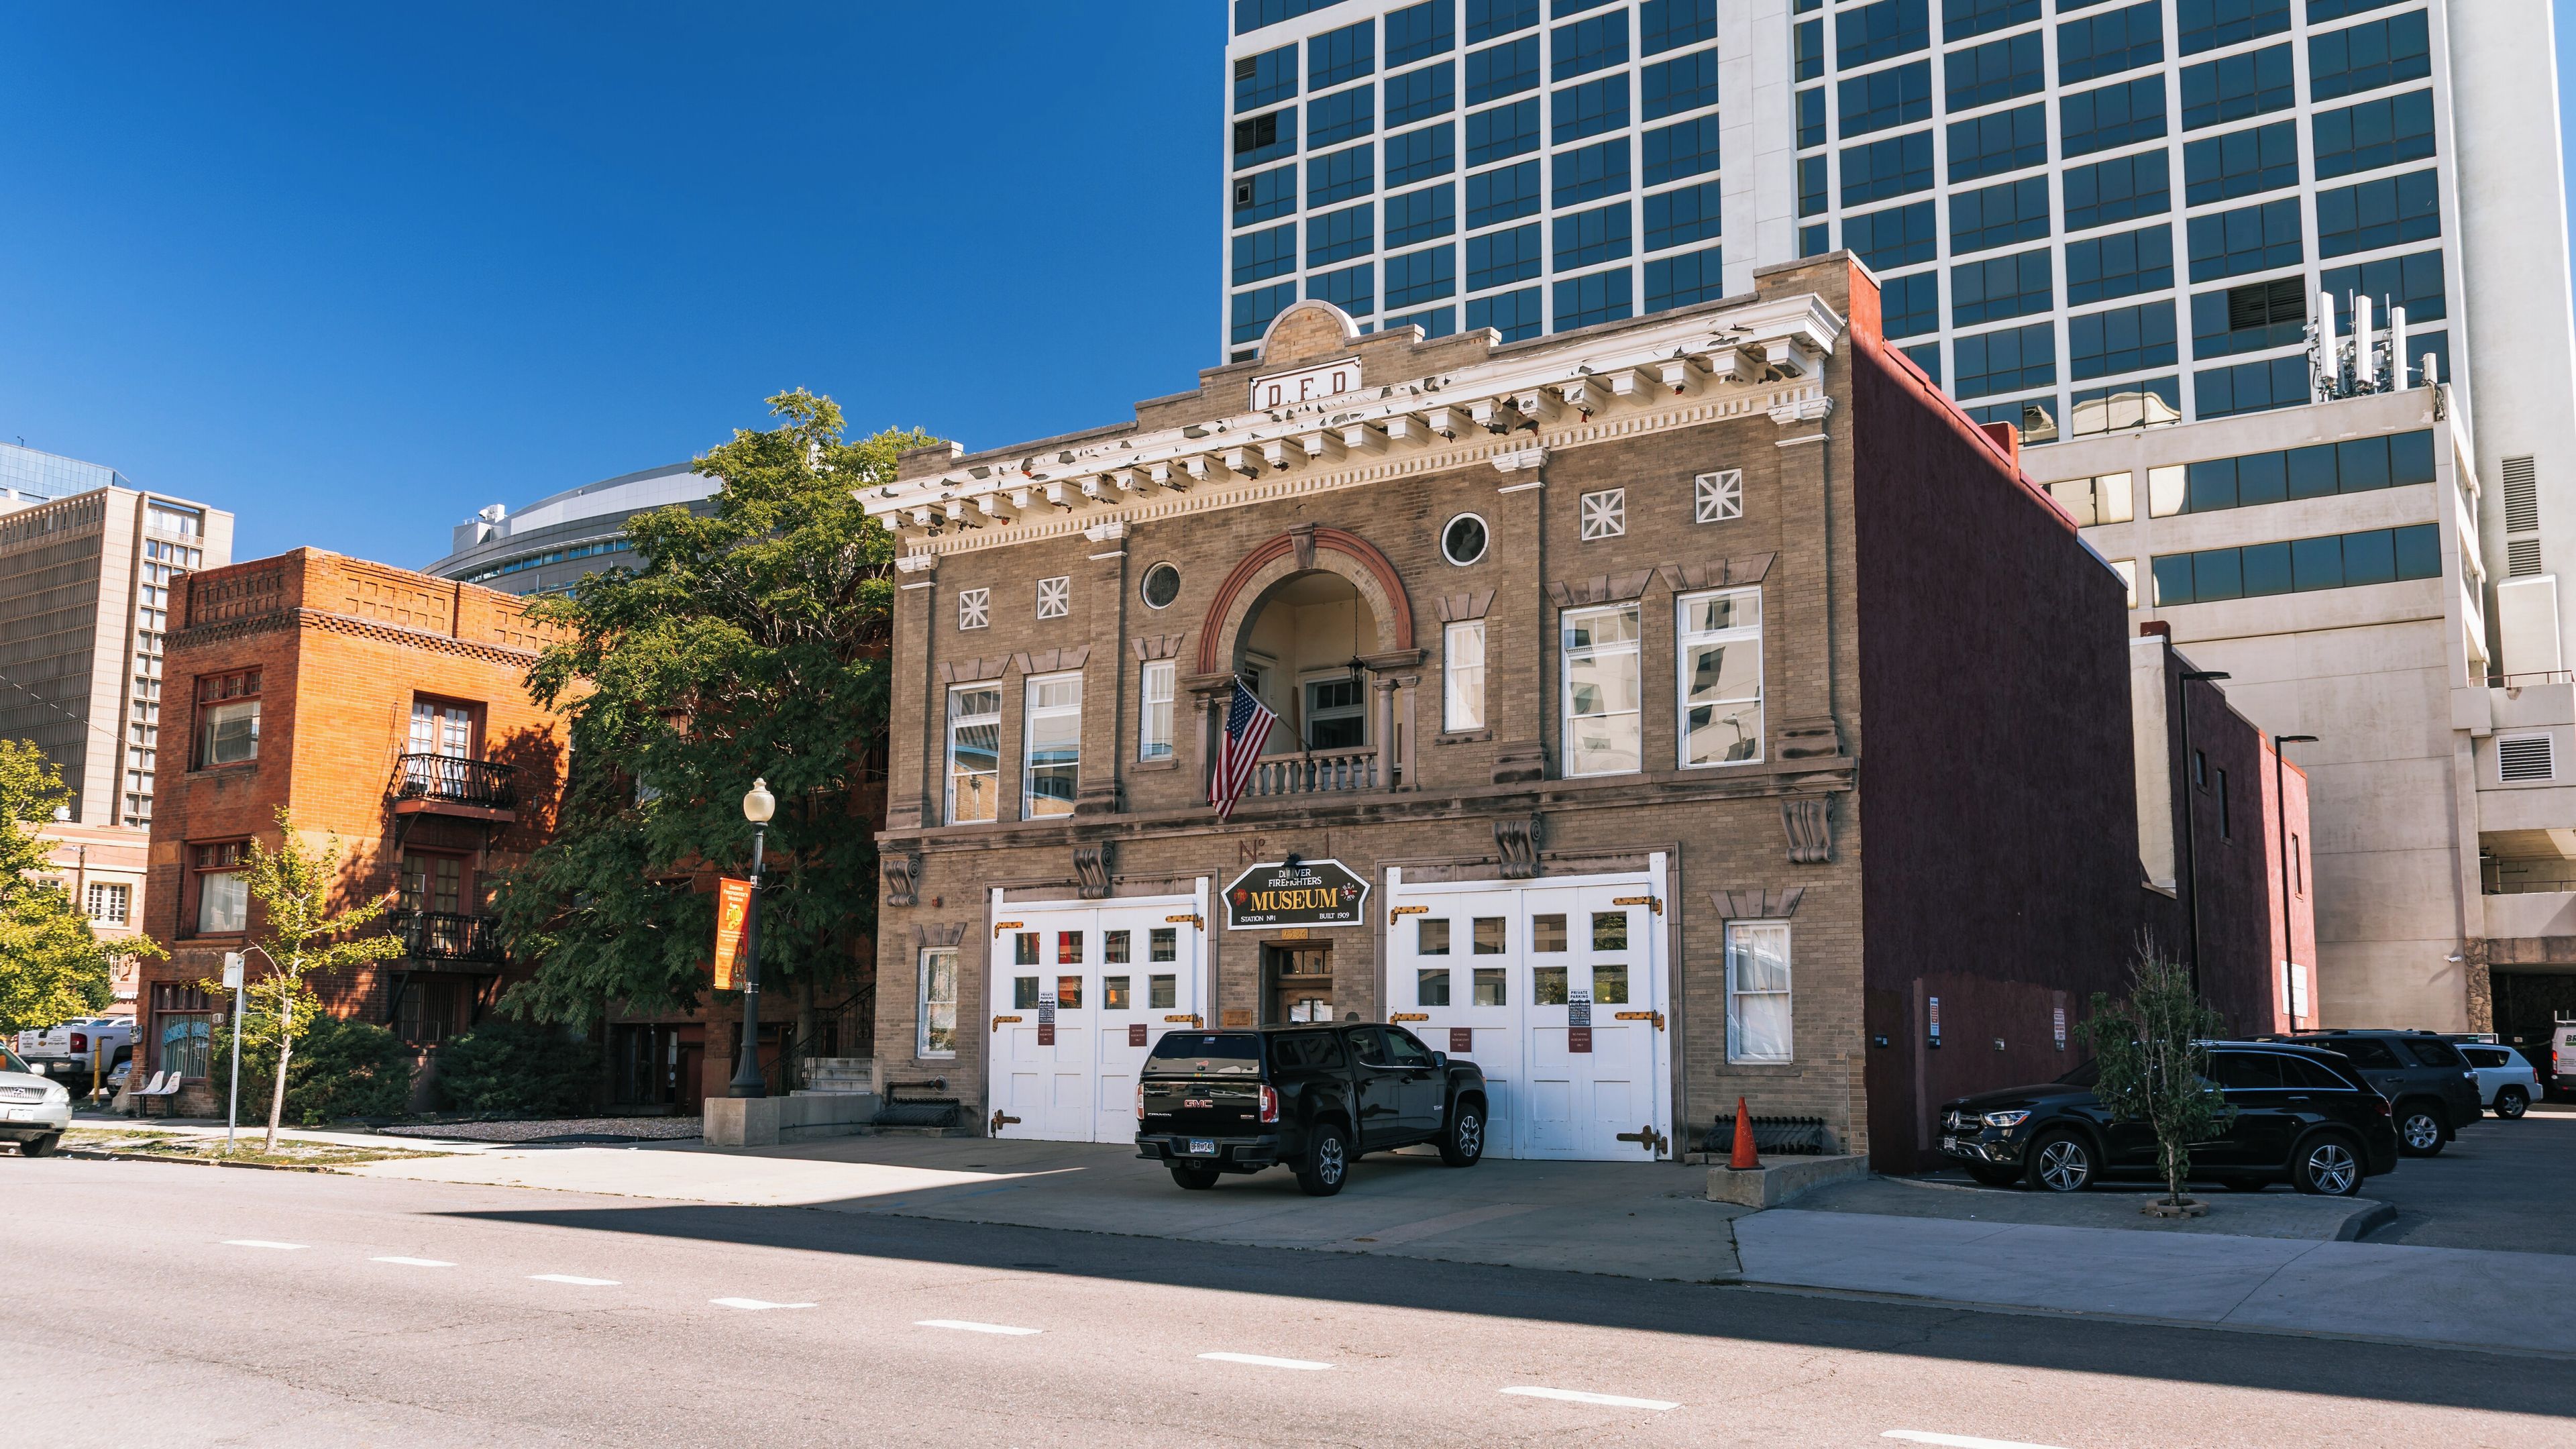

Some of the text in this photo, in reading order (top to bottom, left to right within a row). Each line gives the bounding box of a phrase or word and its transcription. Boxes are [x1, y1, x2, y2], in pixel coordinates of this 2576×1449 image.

[1268, 876, 1322, 887] FIREFIGHTERS
[1250, 888, 1338, 911] MUSEUM
[1185, 1099, 1213, 1108] GMC
